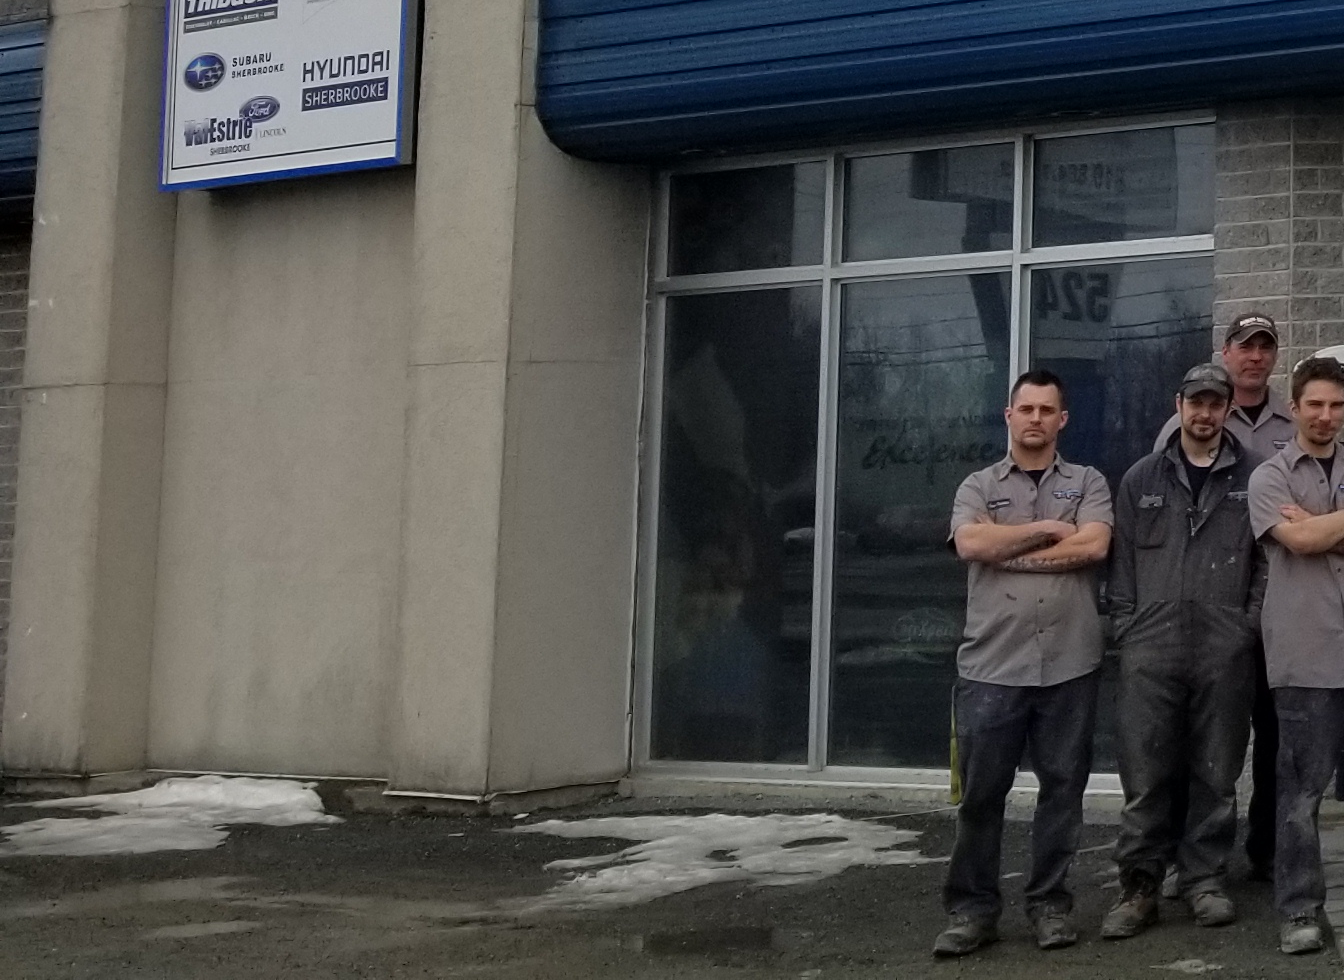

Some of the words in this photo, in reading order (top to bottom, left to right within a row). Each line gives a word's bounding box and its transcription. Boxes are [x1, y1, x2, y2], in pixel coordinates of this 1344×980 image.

[231, 52, 272, 68] SUBARU
[302, 50, 391, 83] HYUNDAI
[231, 64, 284, 79] SHERBROOKE
[305, 81, 386, 107] SHERBROOKE
